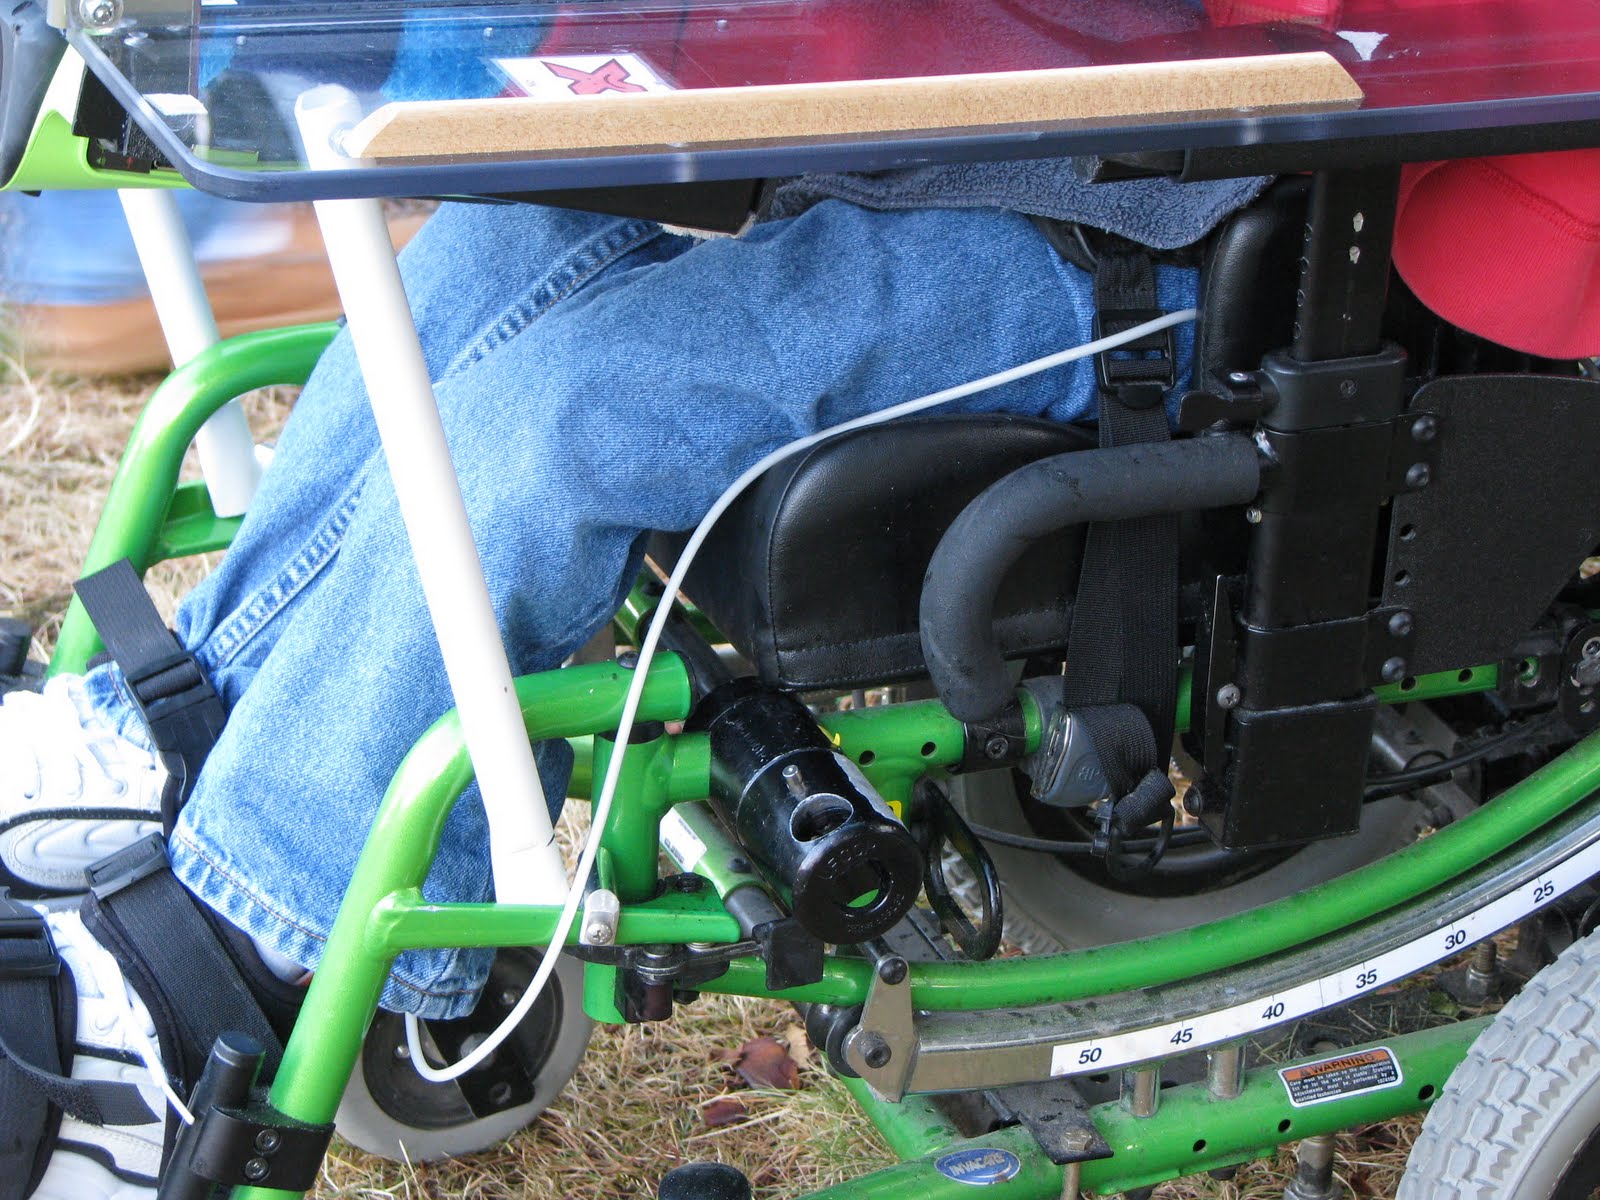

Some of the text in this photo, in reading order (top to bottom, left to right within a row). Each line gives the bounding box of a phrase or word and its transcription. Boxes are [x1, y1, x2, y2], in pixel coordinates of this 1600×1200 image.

[1533, 881, 1554, 903] 25
[1444, 929, 1466, 950] 30
[1355, 969, 1377, 989] 35
[1262, 1002, 1284, 1020] 40
[1170, 1028, 1193, 1045] 45
[1078, 1047, 1102, 1065] 50
[1312, 1053, 1374, 1073] WARNING
